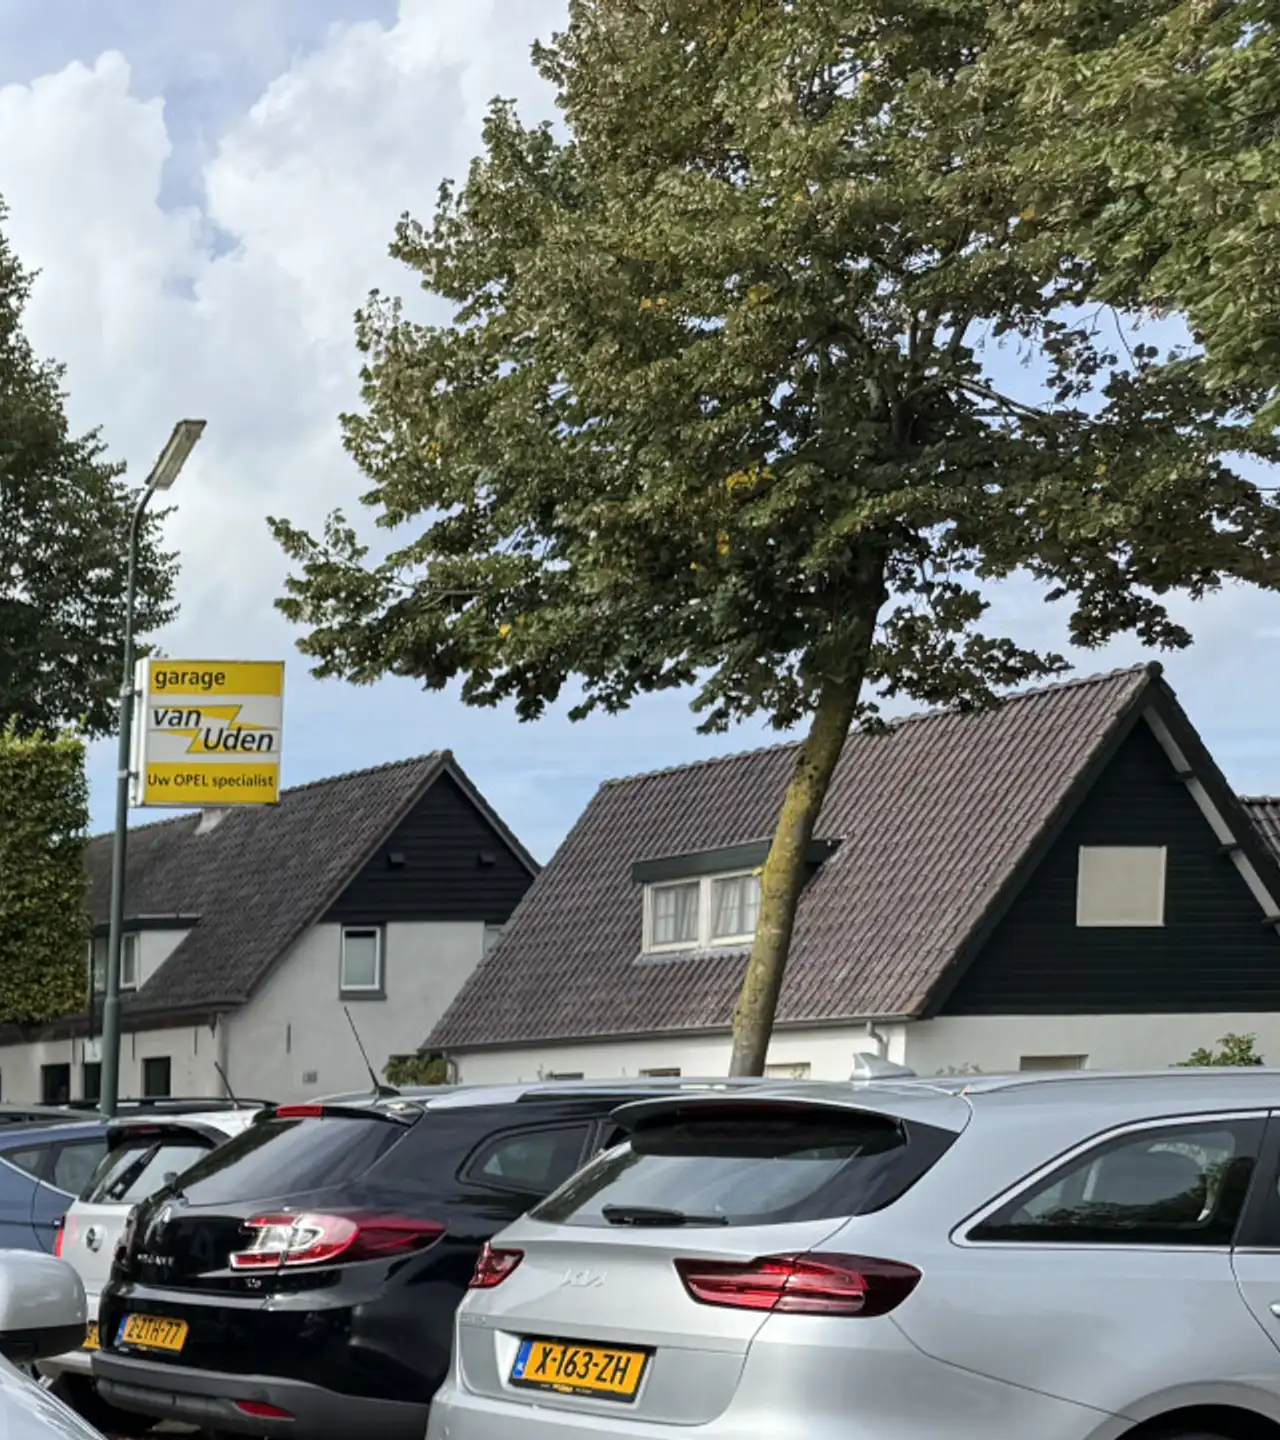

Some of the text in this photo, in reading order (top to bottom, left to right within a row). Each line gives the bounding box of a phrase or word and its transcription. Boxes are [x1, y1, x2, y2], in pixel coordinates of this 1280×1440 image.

[154, 670, 226, 690] garage
[153, 708, 201, 727] van
[203, 727, 273, 752] Uden
[147, 774, 274, 789] Uw OPEL specialist
[535, 1345, 632, 1387] X-163-ZH
